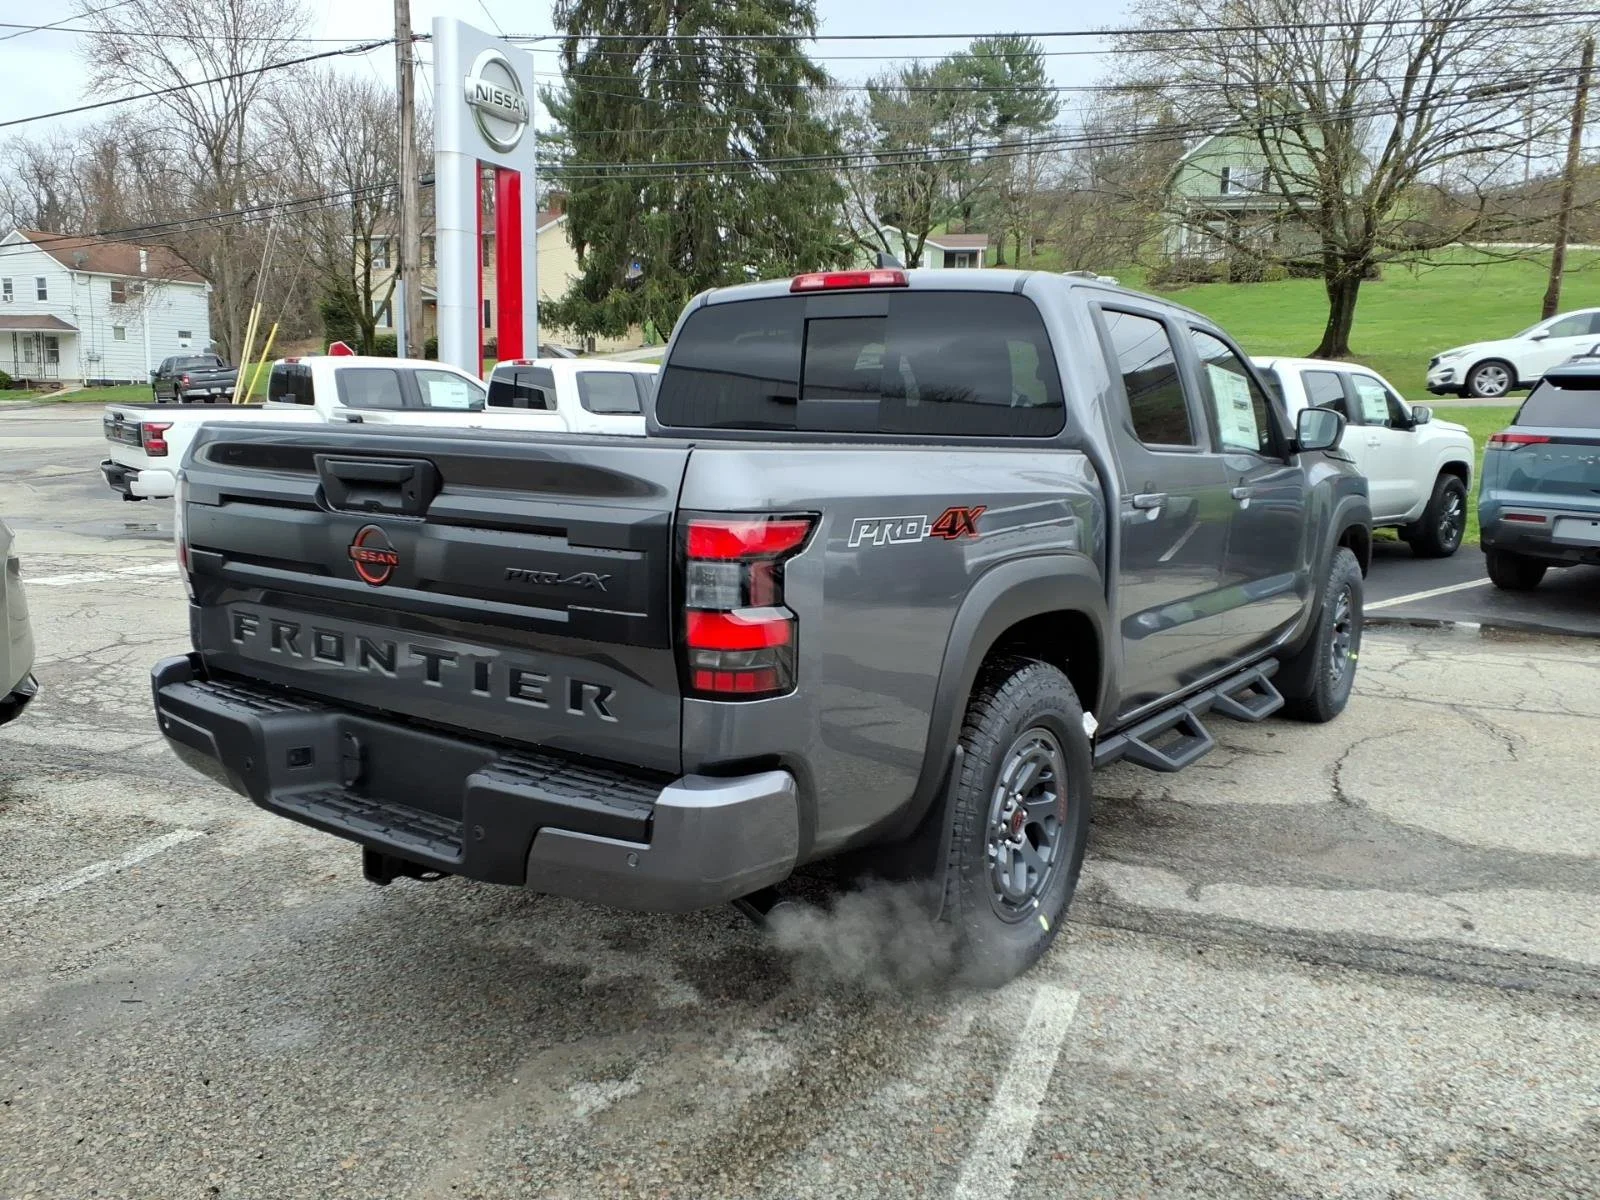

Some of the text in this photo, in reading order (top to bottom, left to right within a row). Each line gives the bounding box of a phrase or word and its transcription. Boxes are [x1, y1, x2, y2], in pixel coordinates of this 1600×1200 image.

[475, 83, 527, 117] NISSAN
[848, 505, 987, 547] PRO-4X
[353, 549, 397, 565] SSAN
[232, 610, 618, 723] FRONTIER
